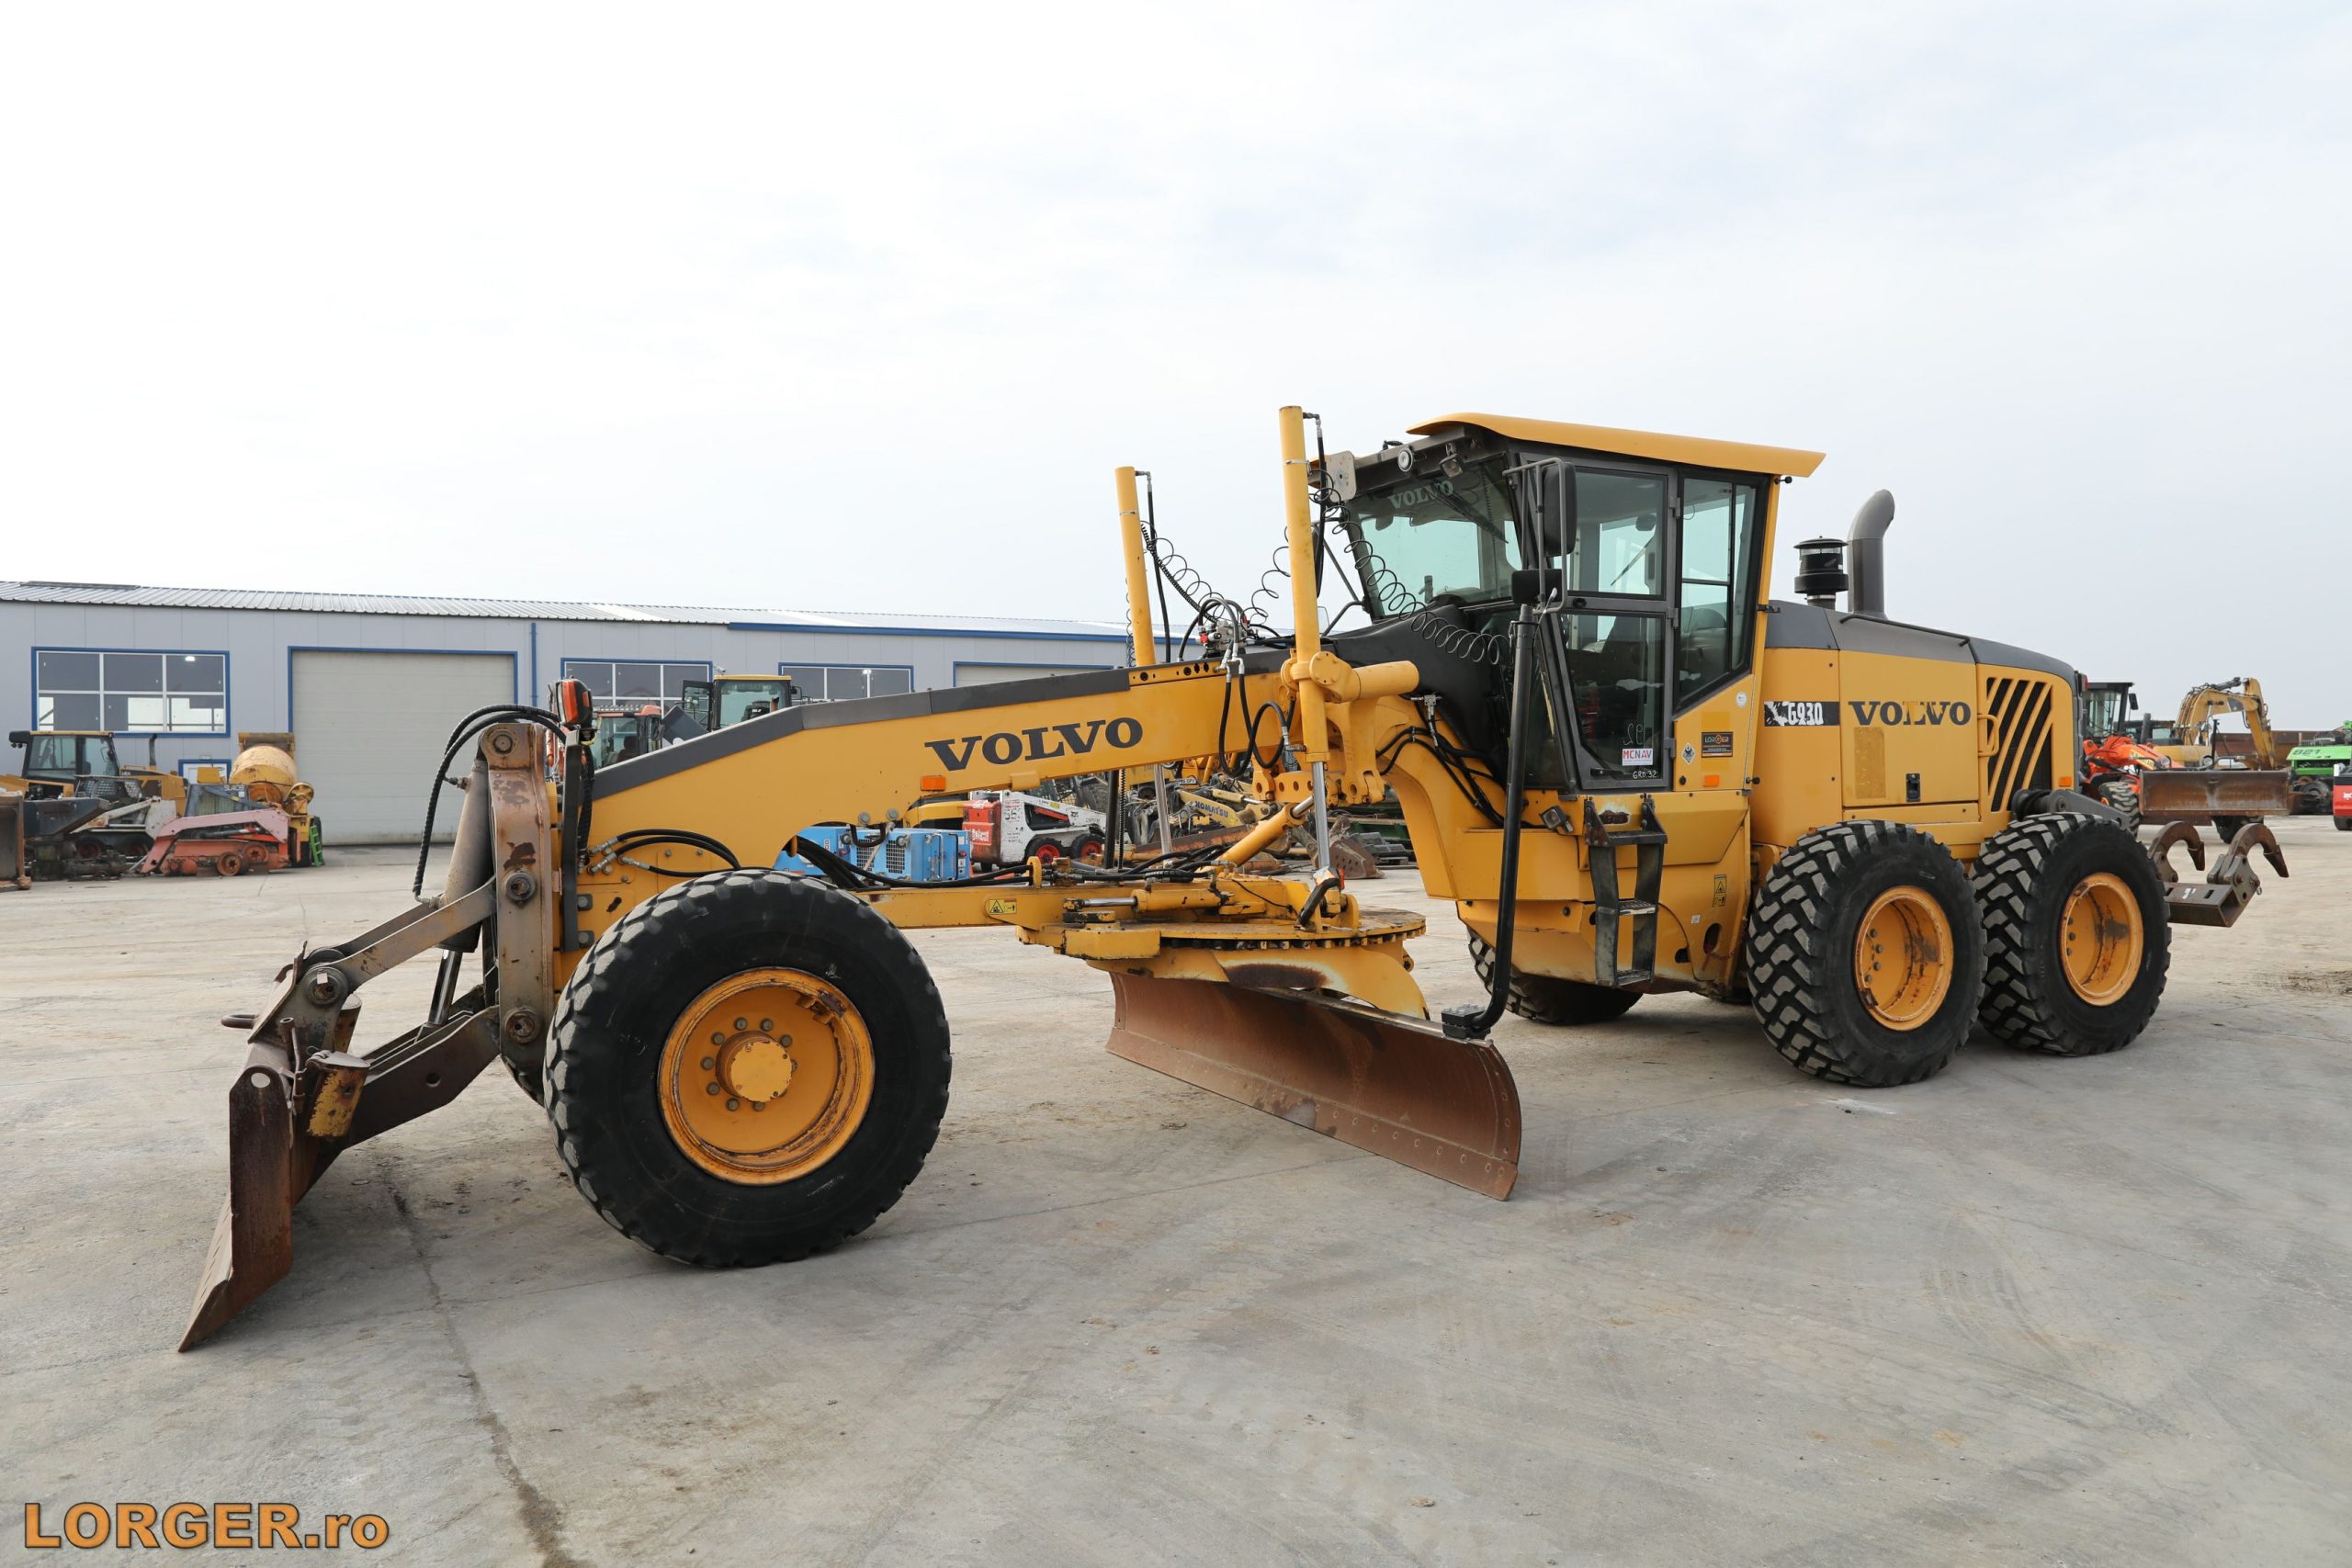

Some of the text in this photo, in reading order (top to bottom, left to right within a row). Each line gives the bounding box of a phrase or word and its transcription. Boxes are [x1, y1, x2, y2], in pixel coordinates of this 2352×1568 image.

[1387, 480, 1453, 509] VOLVO
[1787, 701, 1825, 726] G930
[924, 716, 1143, 772] VOLVO
[1704, 734, 1729, 744] LORGER
[1623, 750, 1652, 759] MCNAV
[1195, 800, 1228, 818] KOMATSU
